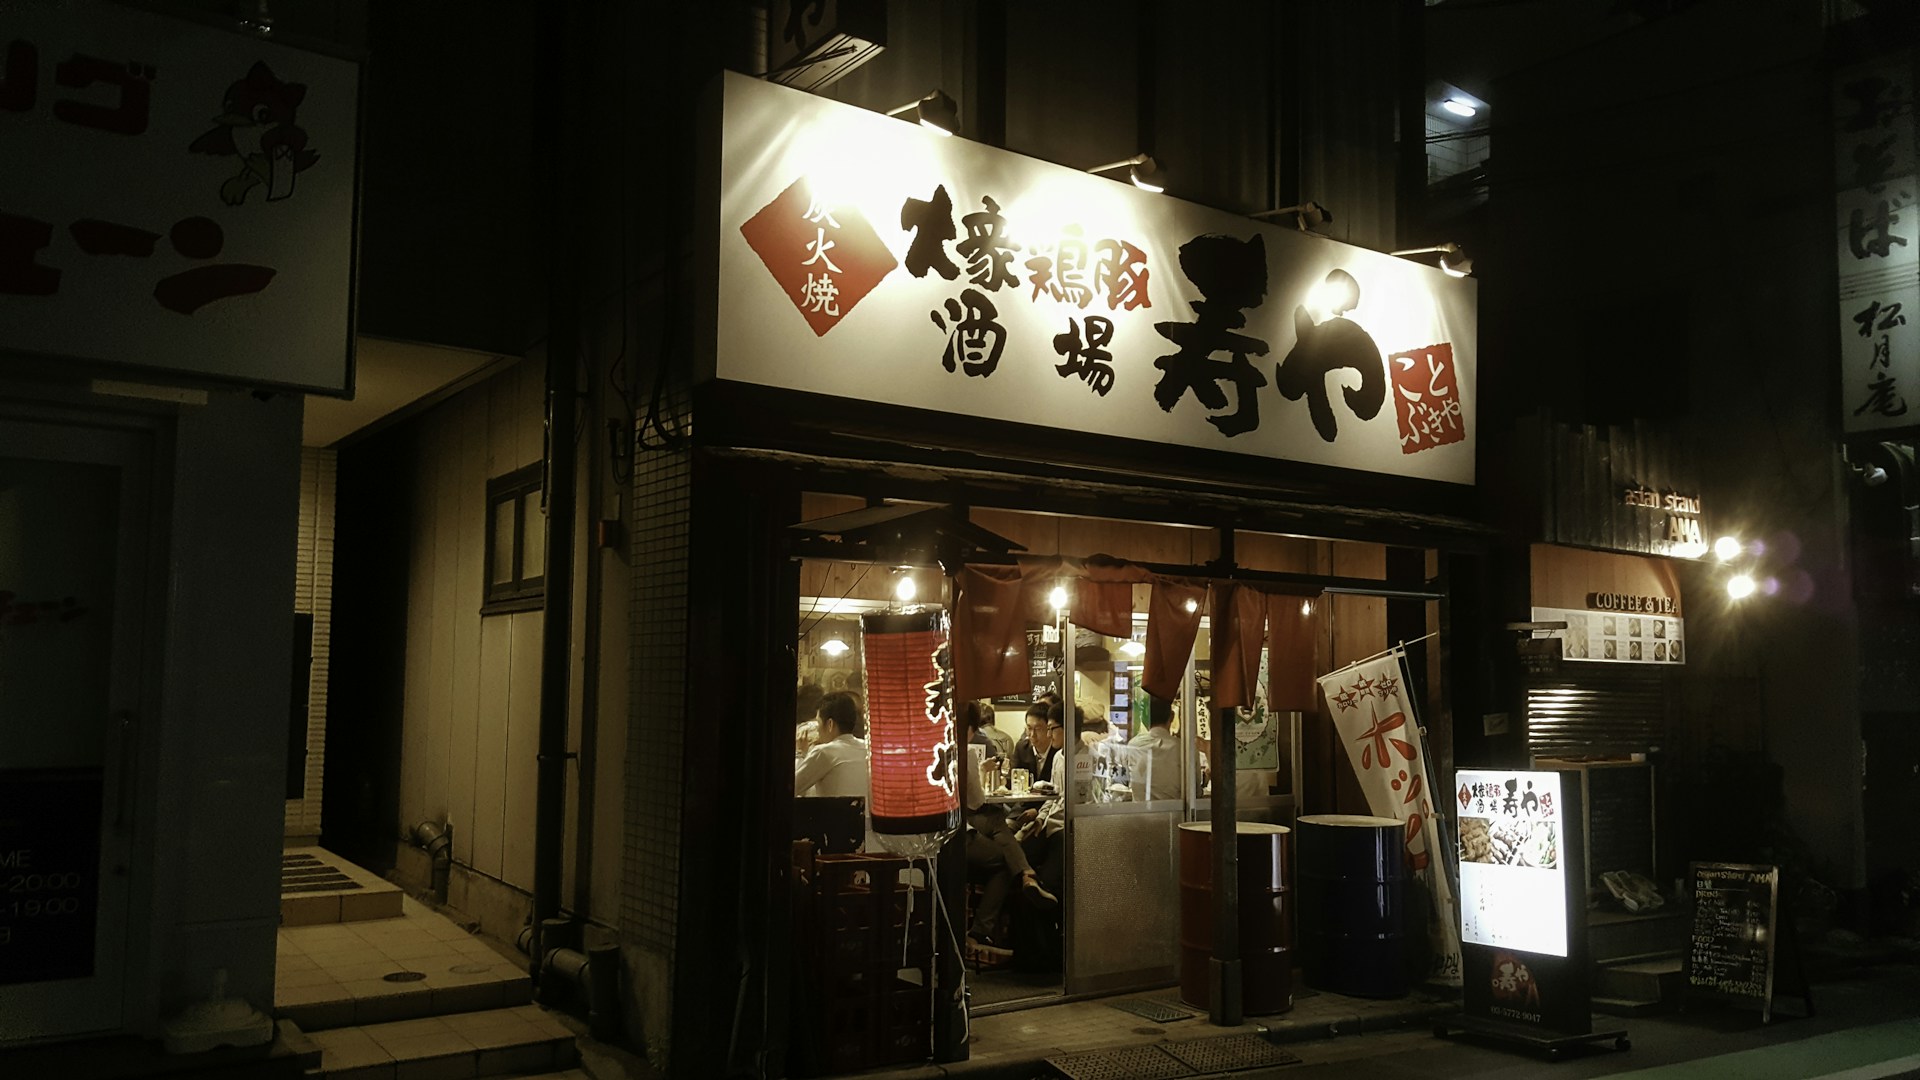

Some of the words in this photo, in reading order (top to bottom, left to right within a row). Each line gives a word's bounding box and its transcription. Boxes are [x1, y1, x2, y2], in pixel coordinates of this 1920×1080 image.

[930, 288, 1115, 398] 酒場
[1153, 233, 1386, 443] 寿や
[1852, 300, 1908, 418] 松月庵
[1596, 592, 1643, 611] COFFEE
[1645, 597, 1655, 613] &
[1656, 596, 1679, 614] TEA
[1076, 761, 1089, 769] au
[1502, 777, 1539, 819] 寿や
